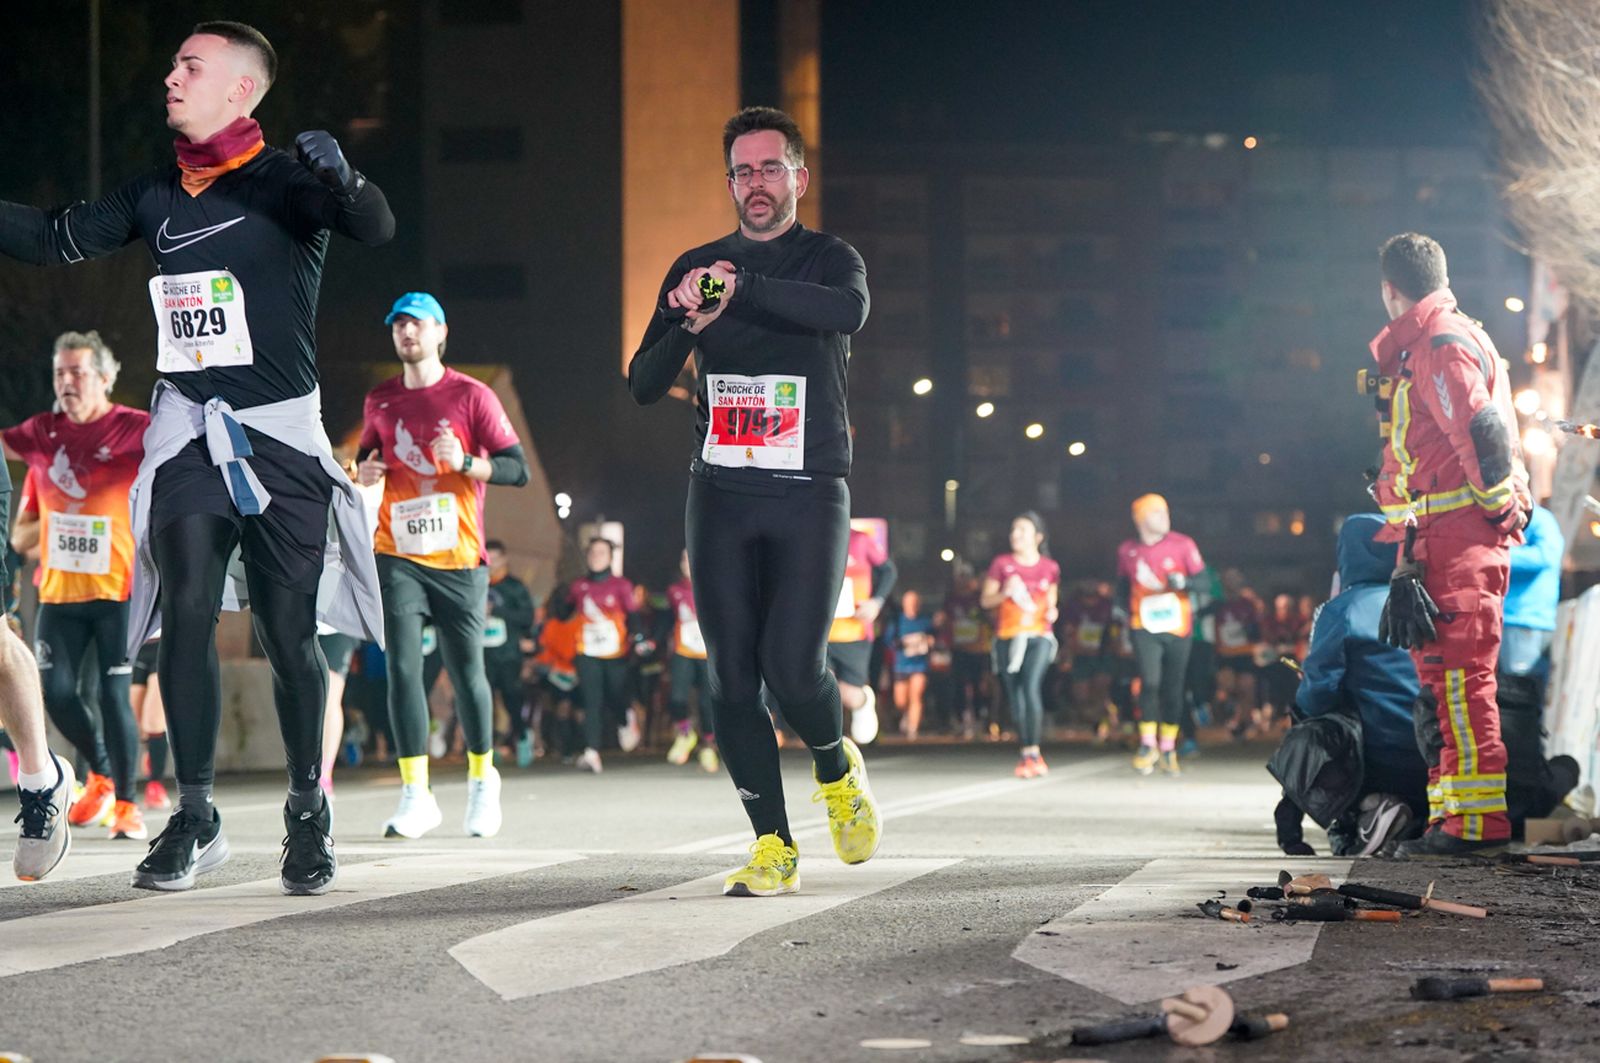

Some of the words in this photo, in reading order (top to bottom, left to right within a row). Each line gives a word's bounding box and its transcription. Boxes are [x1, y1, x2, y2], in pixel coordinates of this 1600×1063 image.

[190, 284, 201, 293] DE
[164, 298, 176, 308] SAN
[171, 307, 227, 339] 6829
[726, 385, 753, 394] NOCHE
[754, 385, 766, 394] DE
[718, 396, 734, 406] SAN
[736, 395, 765, 406] ANTÓN
[407, 517, 443, 535] 6811
[58, 534, 98, 554] 5888
